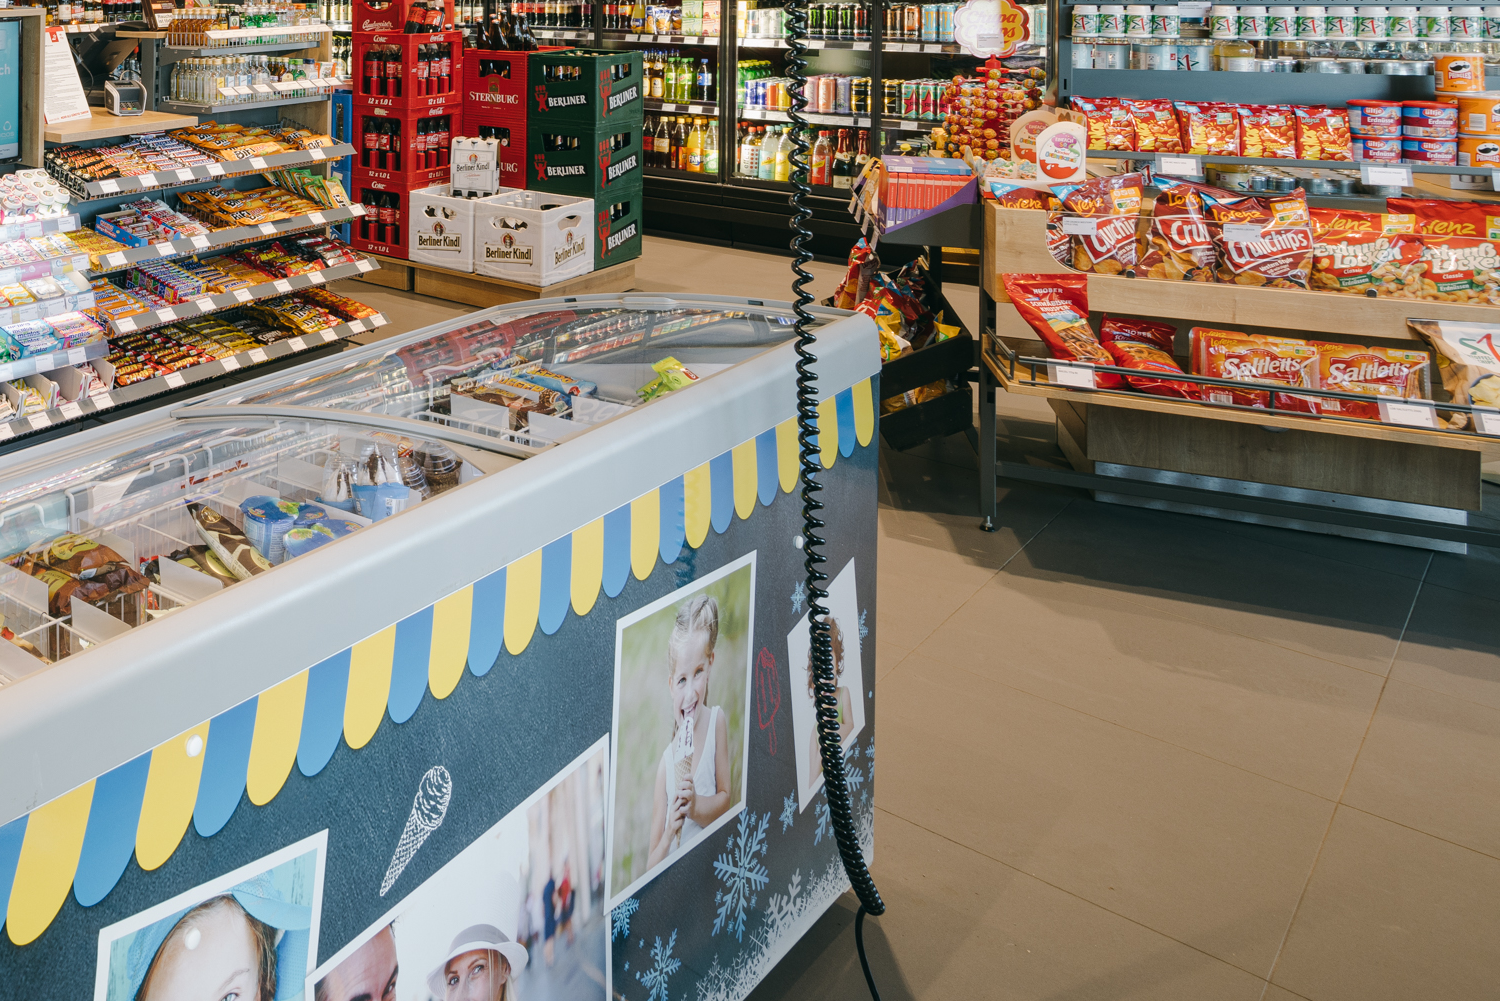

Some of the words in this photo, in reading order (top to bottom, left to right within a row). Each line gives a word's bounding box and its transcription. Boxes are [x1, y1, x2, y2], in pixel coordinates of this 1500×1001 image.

[1448, 71, 1472, 81] PRINGLES
[469, 91, 519, 105] STERNBURG
[548, 95, 587, 107] BERLINER
[609, 87, 638, 109] BERLINER
[456, 163, 475, 172] Berliner
[476, 161, 490, 171] Kindl
[547, 165, 586, 176] BERLINER
[608, 155, 637, 180] BERLINER
[1214, 207, 1264, 225] Lorenz
[418, 235, 442, 248] Berliner
[443, 234, 460, 248] Kindl
[607, 224, 636, 250] BERLINER
[486, 246, 512, 260] Berliner
[513, 247, 532, 261] Kindl
[1230, 231, 1308, 265] Crunchips
[1314, 238, 1389, 257] Erdnuß
[1333, 248, 1402, 269] Locken
[1210, 338, 1238, 347] Lorenz
[1222, 356, 1301, 379] Saltletts
[1327, 361, 1411, 385] Saltletts
